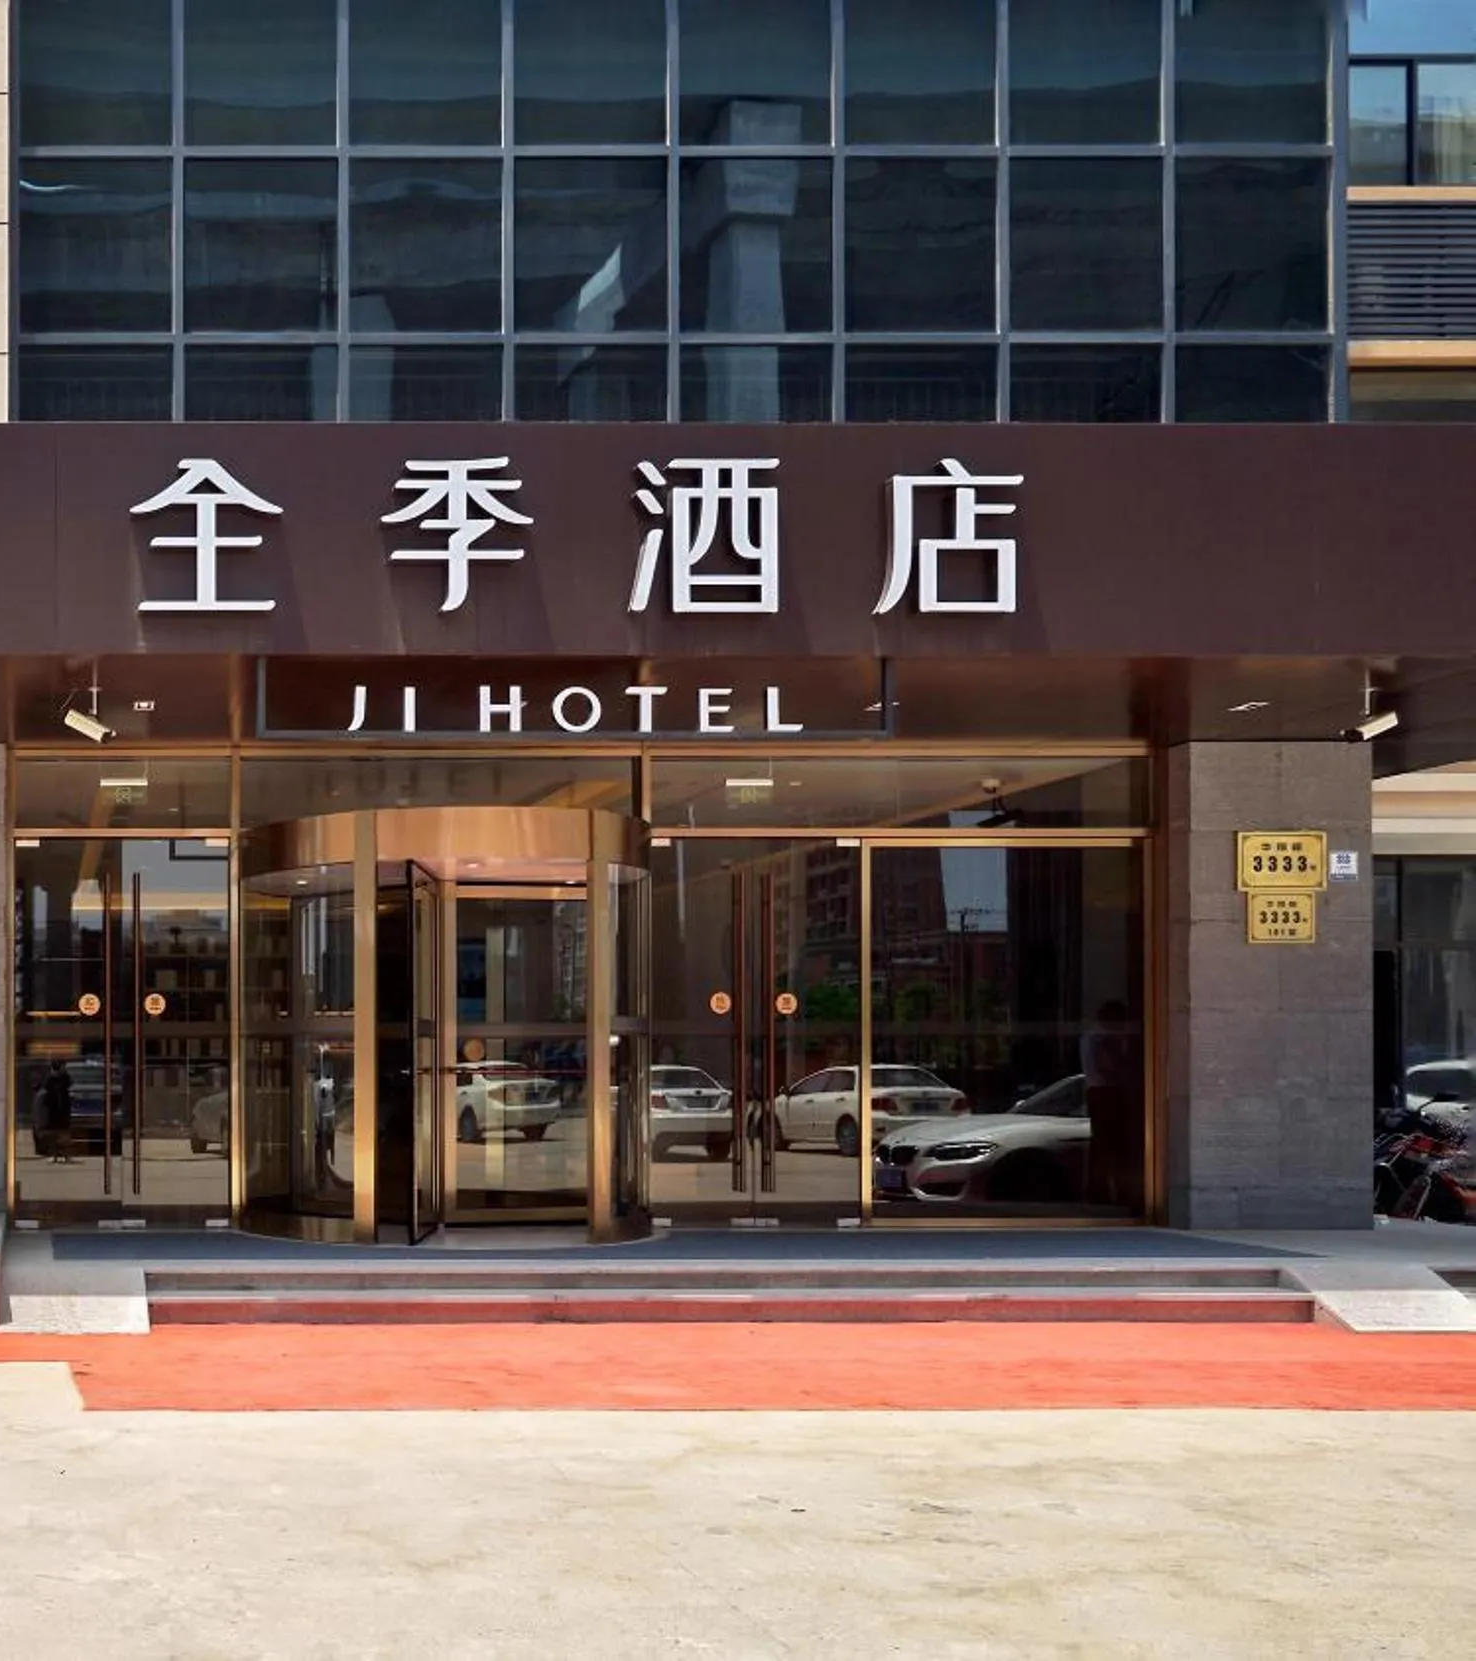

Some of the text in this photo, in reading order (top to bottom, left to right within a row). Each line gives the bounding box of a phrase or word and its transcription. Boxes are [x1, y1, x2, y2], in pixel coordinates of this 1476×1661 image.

[129, 457, 1024, 613] 全季酒店
[347, 685, 804, 733] JI HOTEL
[1253, 855, 1317, 872] 3333
[1259, 911, 1308, 924] 3333
